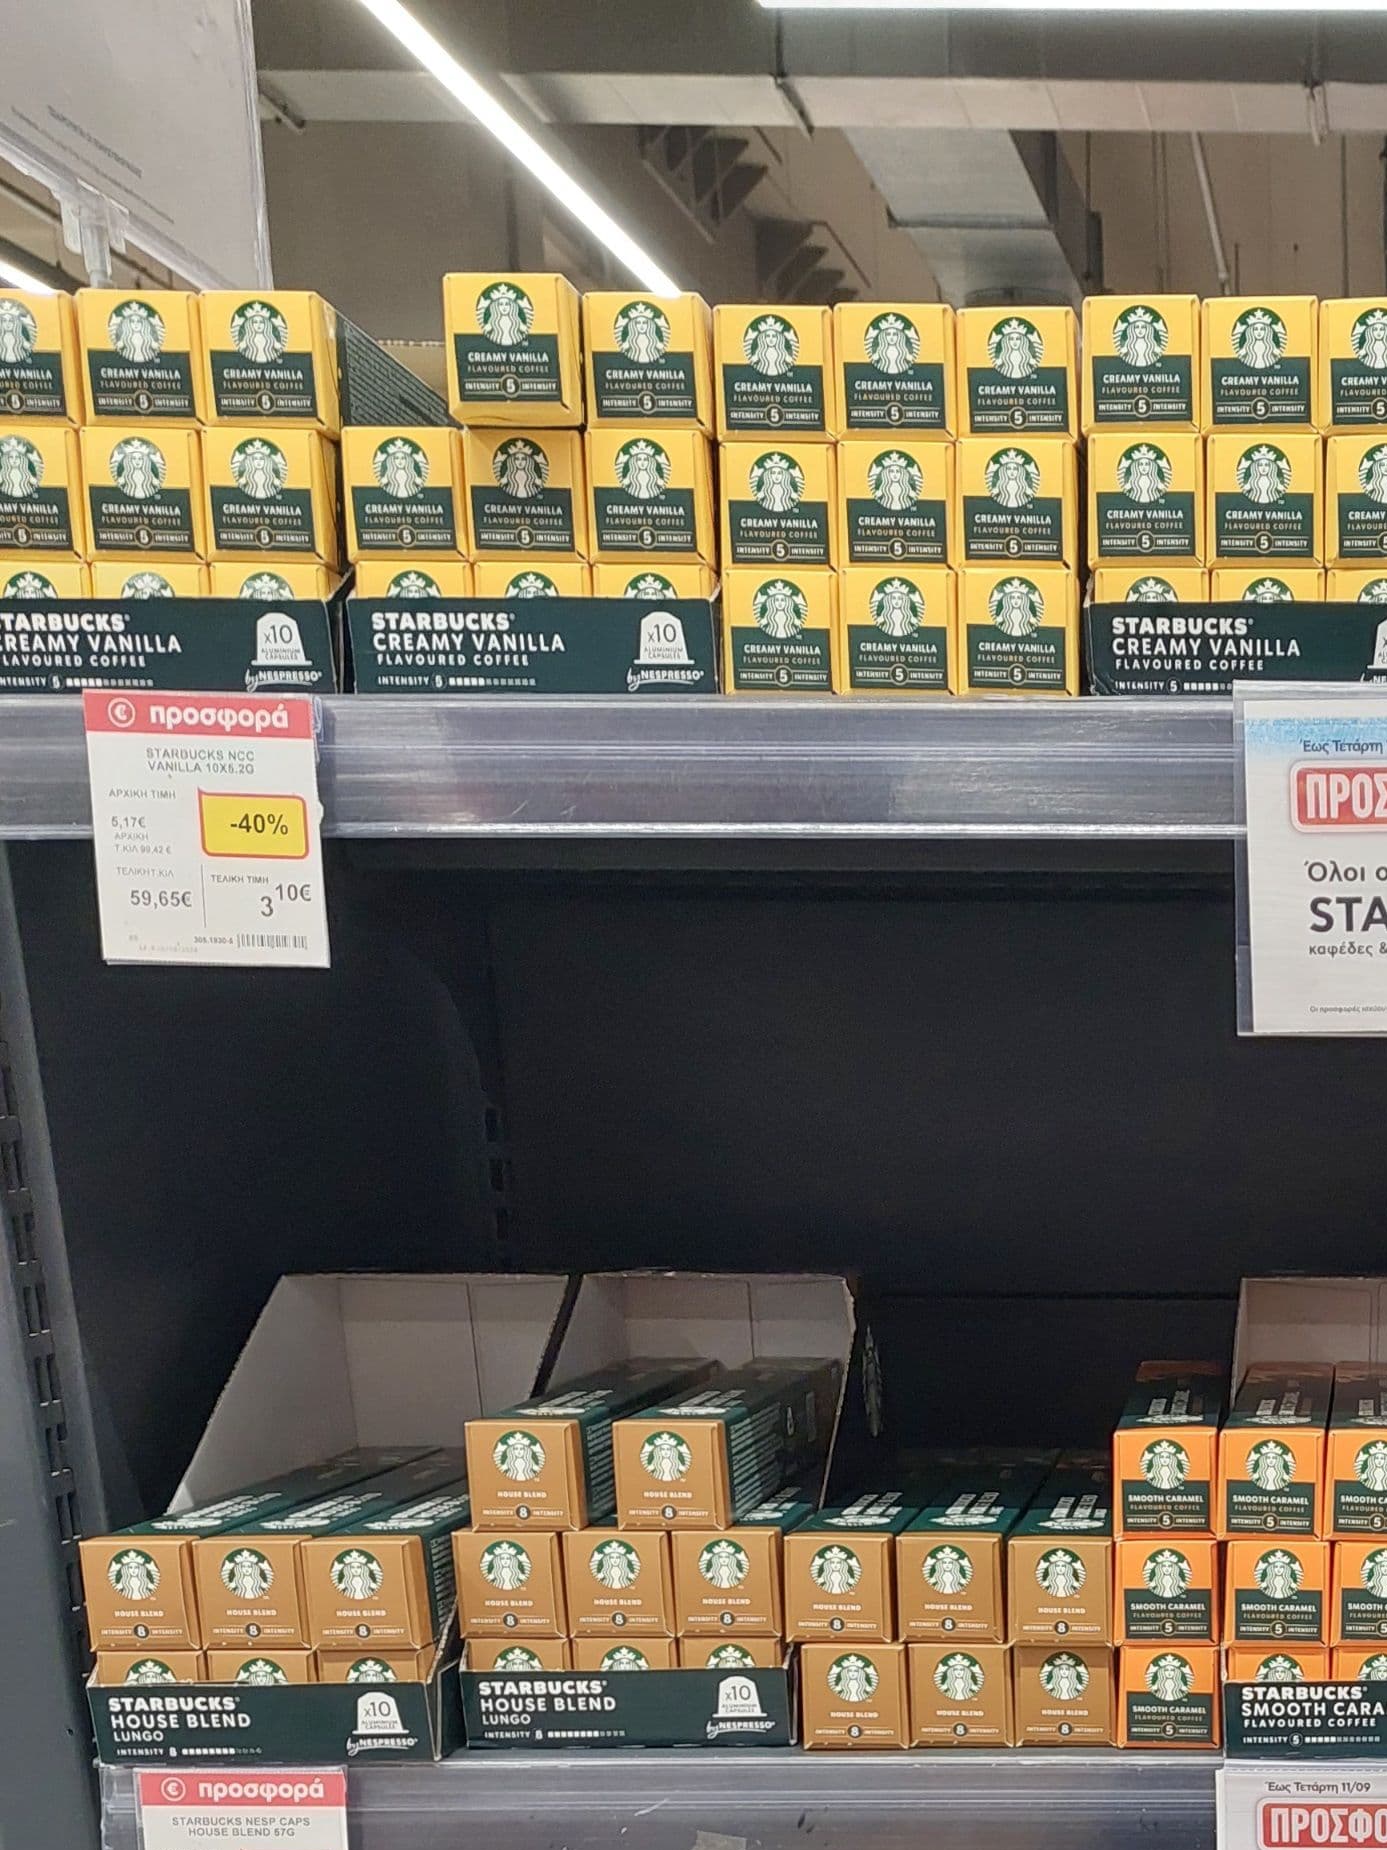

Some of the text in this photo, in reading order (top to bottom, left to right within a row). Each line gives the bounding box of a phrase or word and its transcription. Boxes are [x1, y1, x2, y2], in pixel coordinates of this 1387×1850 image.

[372, 612, 508, 631] STARBUCKS
[647, 623, 677, 645] x10
[373, 632, 565, 653] CREAMY VANILLA
[150, 704, 288, 733] προσφορά
[146, 748, 255, 761] STARBUCKS NCC
[1333, 738, 1383, 756] Τετάρτη
[148, 761, 202, 773] VANILLA
[111, 815, 146, 830] 5,17€
[230, 813, 289, 837] -40%
[1305, 861, 1365, 885] Όλοι
[130, 888, 192, 910] 59,65€
[1309, 941, 1373, 958] καφέδες
[1128, 1495, 1204, 1503] SMOOTH CARAMEL
[1242, 1686, 1362, 1700] STARBUCKS
[109, 1697, 235, 1712] STARBUCKS
[364, 1701, 391, 1719] x10
[1242, 1702, 1325, 1717] SMOOTH
[111, 1713, 251, 1728] HOUSE BLEND
[114, 1731, 164, 1742] LUNGO
[199, 1779, 324, 1802] προσφορά
[1294, 1781, 1339, 1795] Τετάρτη
[1341, 1780, 1371, 1794] 11/09
[172, 1817, 310, 1827] STARBUCKS NESP CAPS
[188, 1828, 228, 1837] HOUSE
[232, 1828, 270, 1837] BLEND
